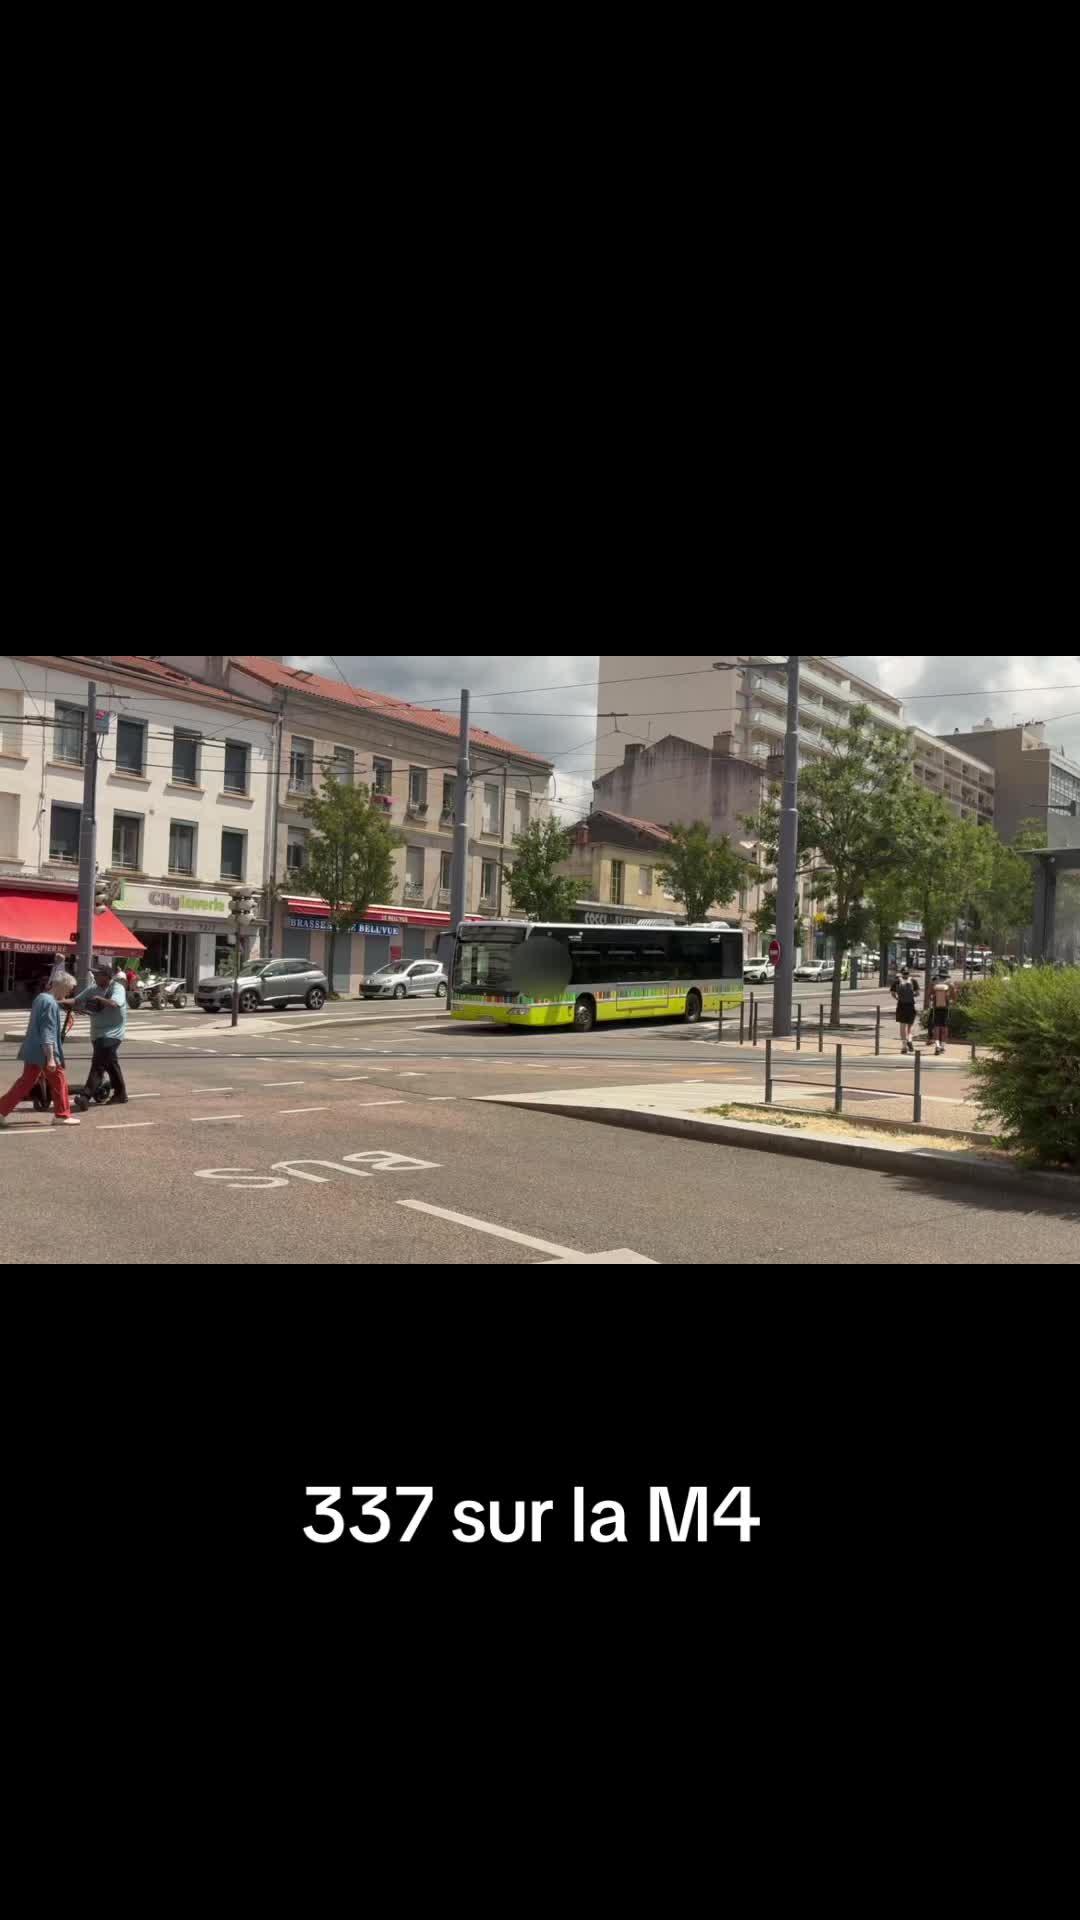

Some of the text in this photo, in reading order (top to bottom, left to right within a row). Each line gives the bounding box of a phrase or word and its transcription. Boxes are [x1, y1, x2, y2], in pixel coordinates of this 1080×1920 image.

[1, 942, 67, 953] LE ROBESPIERRE
[194, 1150, 445, 1189] BUS
